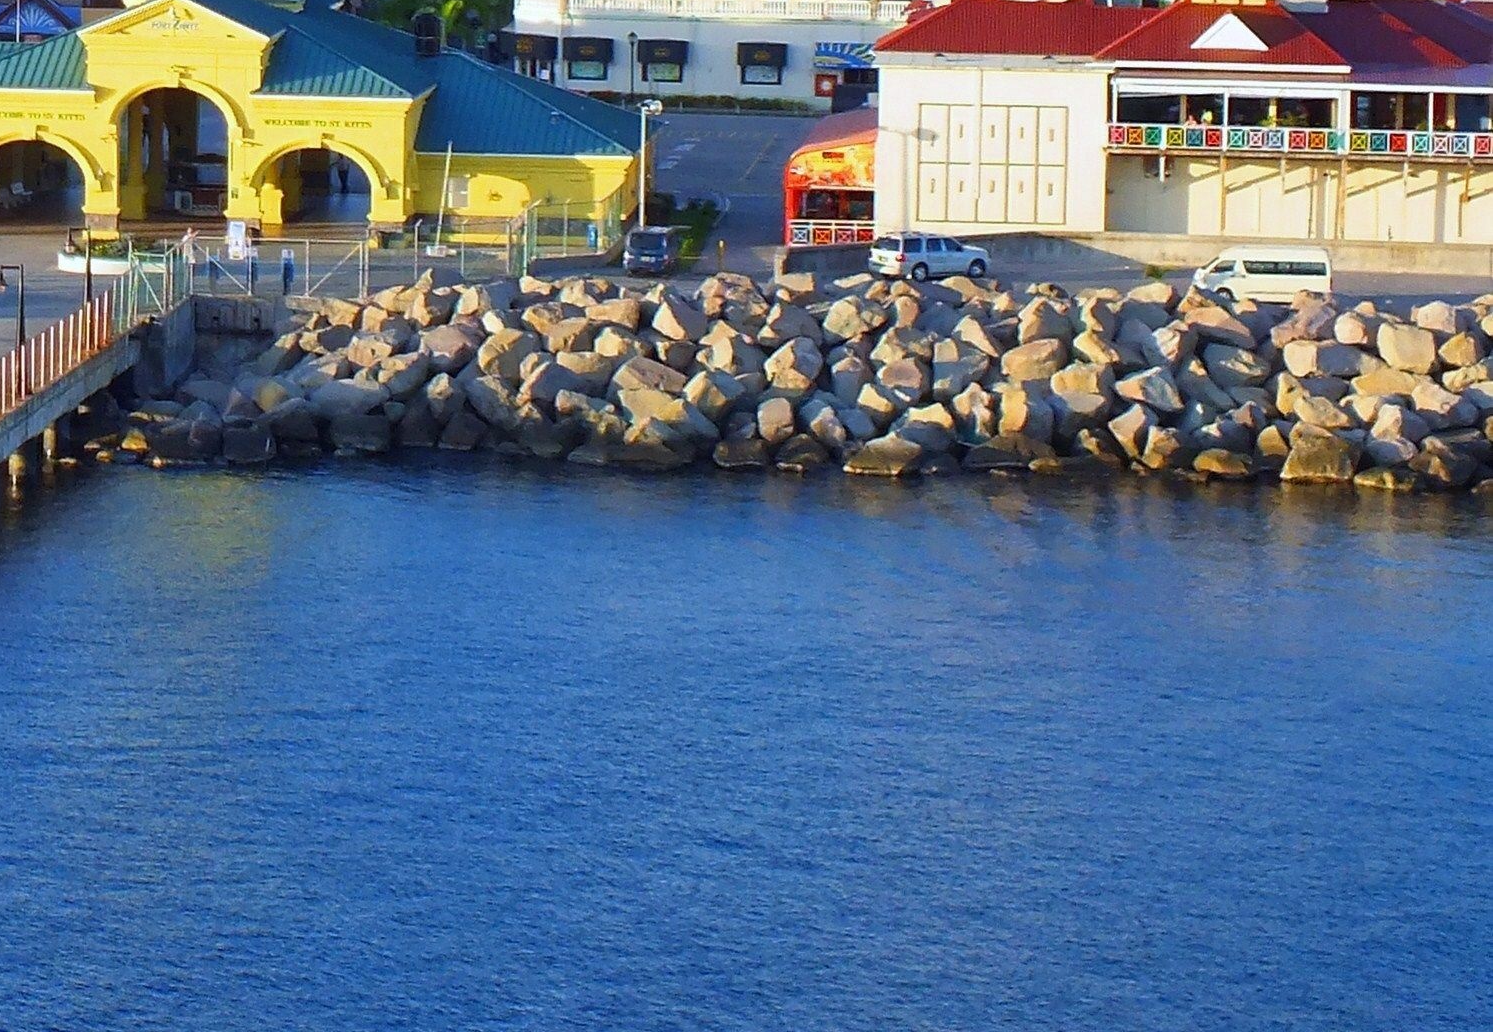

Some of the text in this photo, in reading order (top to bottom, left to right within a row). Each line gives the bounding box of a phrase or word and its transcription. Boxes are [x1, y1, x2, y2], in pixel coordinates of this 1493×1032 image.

[58, 113, 86, 121] KITTS
[264, 119, 310, 127] WELCOME
[344, 121, 373, 129] KITTS
